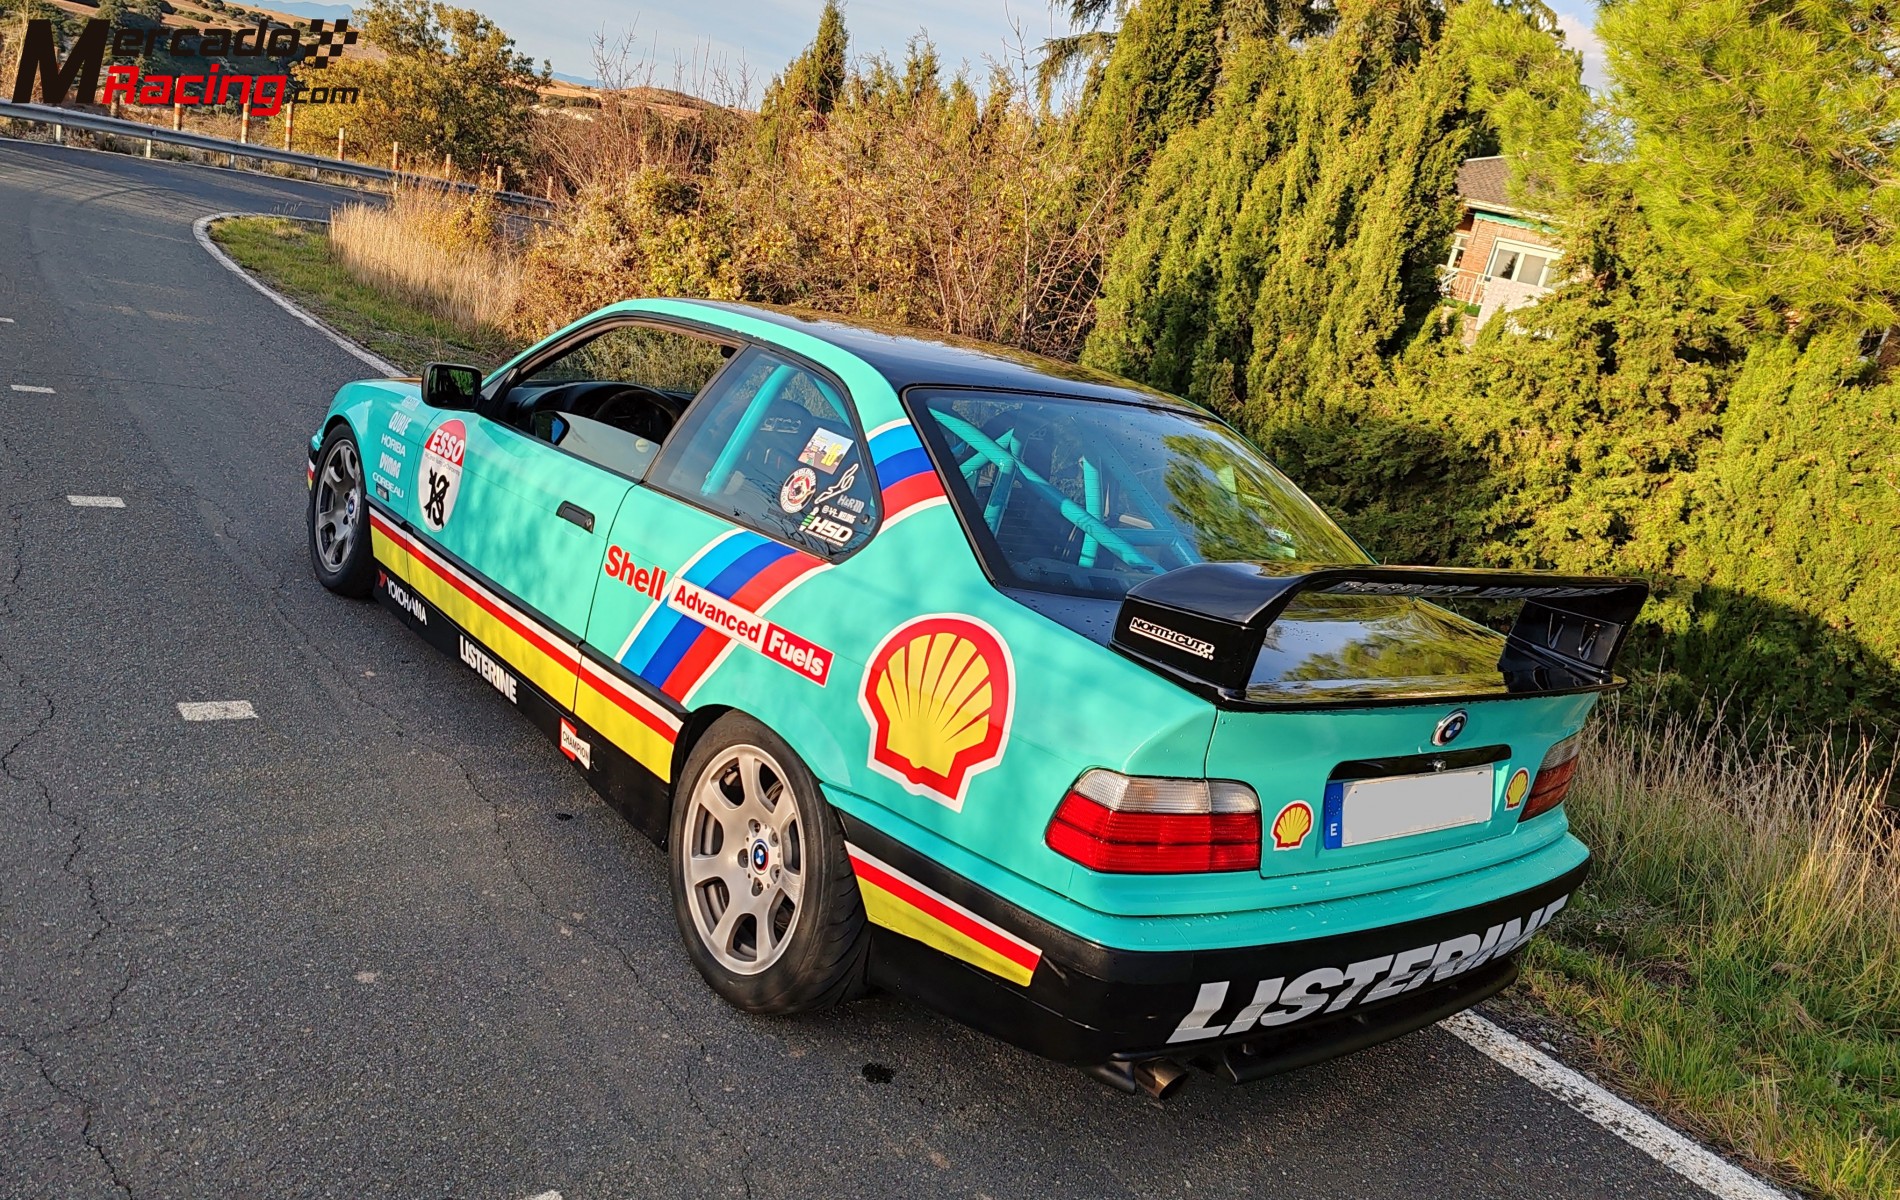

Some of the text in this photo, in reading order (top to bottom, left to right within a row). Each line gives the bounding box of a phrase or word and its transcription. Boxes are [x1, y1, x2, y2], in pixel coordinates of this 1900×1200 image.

[381, 433, 406, 457] HORIBA
[429, 428, 465, 463] ESSO
[372, 471, 405, 499] CORBEAU
[808, 516, 854, 543] HSD
[605, 545, 667, 600] Shell
[386, 576, 428, 626] YOKOHAMA
[673, 585, 762, 643] Advanced
[459, 634, 517, 704] LISTERINE
[768, 630, 824, 677] Fuels
[562, 729, 590, 762] CHAMPION
[1330, 822, 1338, 837] E
